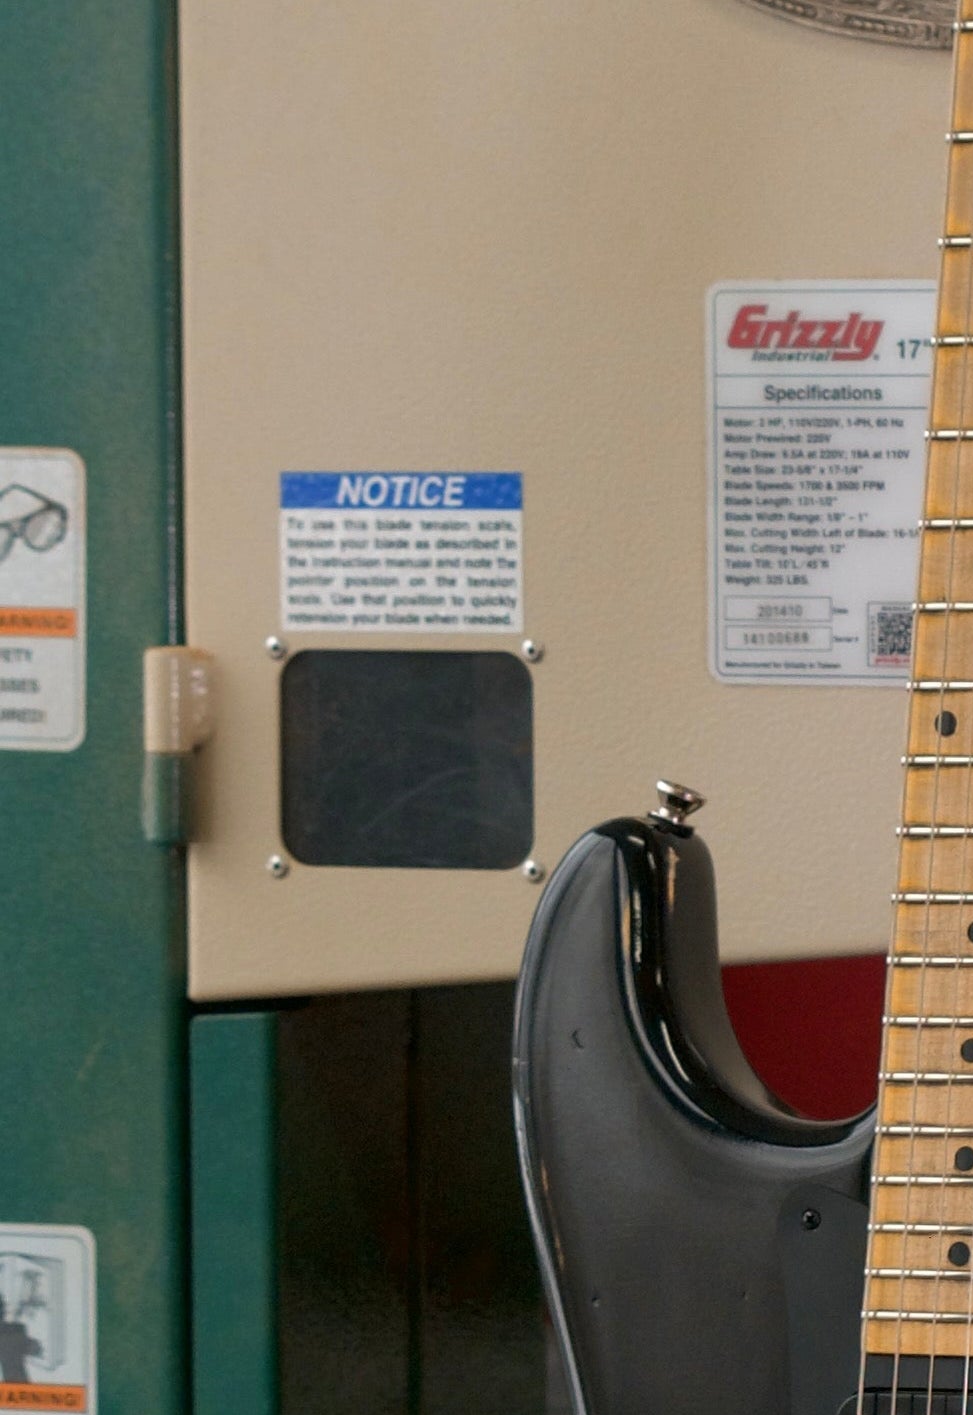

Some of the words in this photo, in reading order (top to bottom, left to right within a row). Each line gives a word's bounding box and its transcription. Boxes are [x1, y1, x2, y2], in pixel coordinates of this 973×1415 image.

[727, 304, 885, 362] Grizzly
[752, 351, 830, 362] Industrial
[764, 384, 882, 403] Specifications
[335, 475, 467, 507] NOTICE
